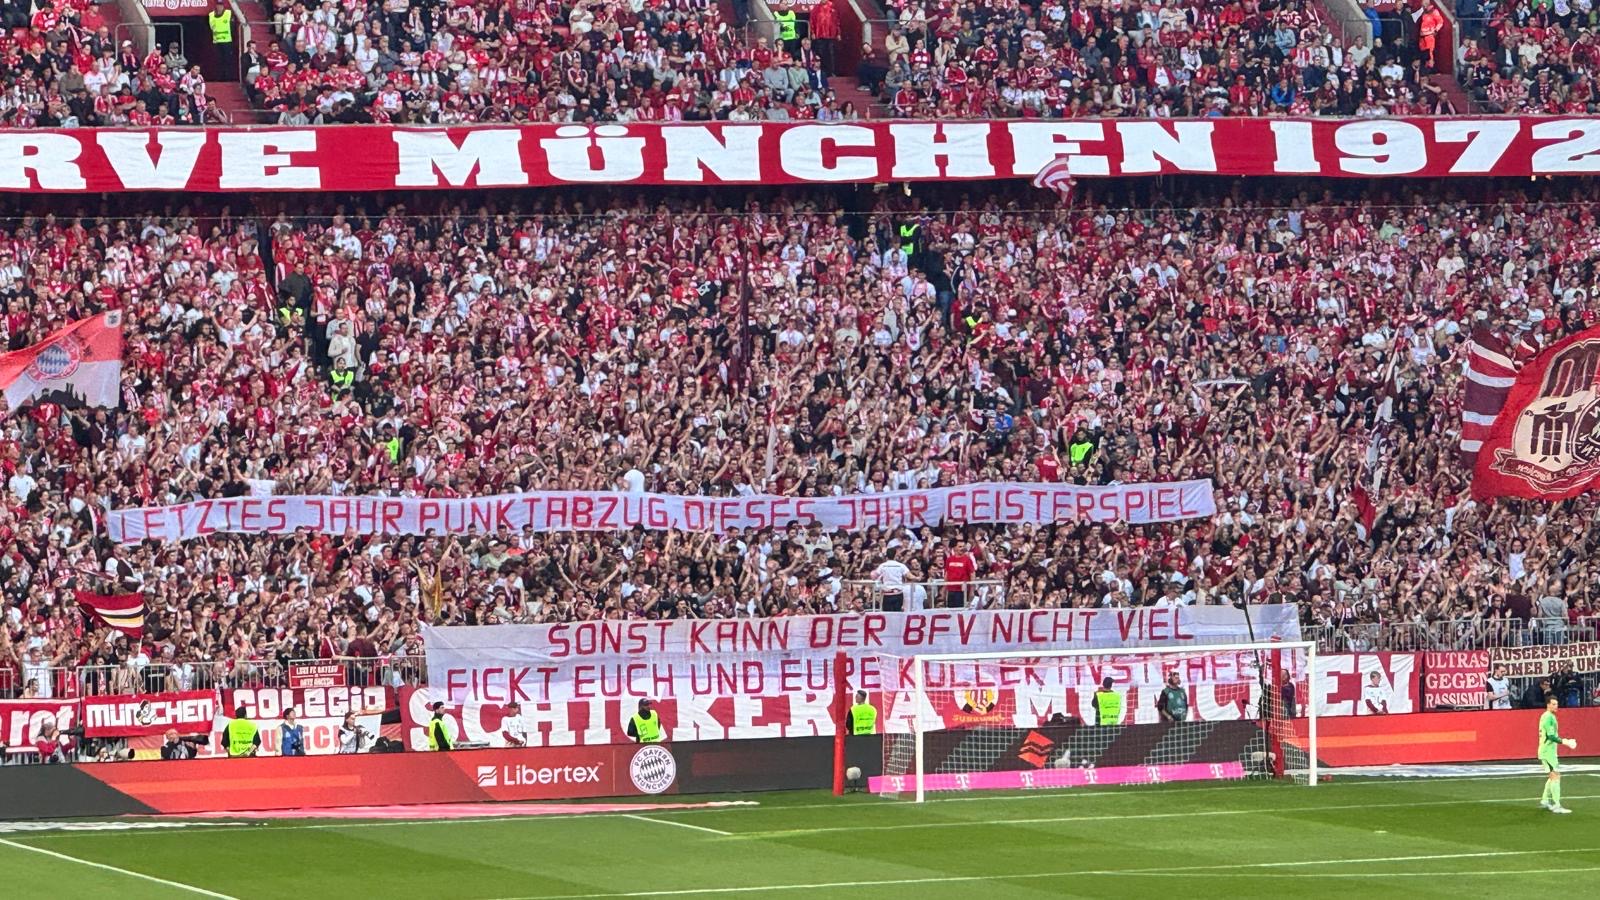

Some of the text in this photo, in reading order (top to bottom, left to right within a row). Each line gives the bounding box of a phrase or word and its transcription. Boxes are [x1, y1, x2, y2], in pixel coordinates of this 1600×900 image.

[0, 119, 1600, 190] RVE MÜNCHEN 1972
[121, 499, 287, 543] LETZTES
[304, 499, 403, 533] JAHR
[685, 498, 816, 533] DIESES
[838, 495, 929, 530] JAHR
[946, 487, 1197, 523] GEISTERSPIEL
[549, 608, 1194, 658] SONST KANN DER BFV NICHT VIEL
[447, 667, 559, 702] FICKT
[574, 663, 674, 698] EUCH
[690, 661, 764, 696] UND
[781, 656, 881, 692] EURE
[1425, 671, 1489, 689] GEGEN
[1426, 651, 1489, 668] ULTRAS
[10, 705, 75, 746] rot
[409, 686, 947, 752] SCHICKERA
[503, 764, 600, 786] Libertex
[643, 749, 671, 766] BAYERN
[635, 773, 672, 790] MÜNCHEN
